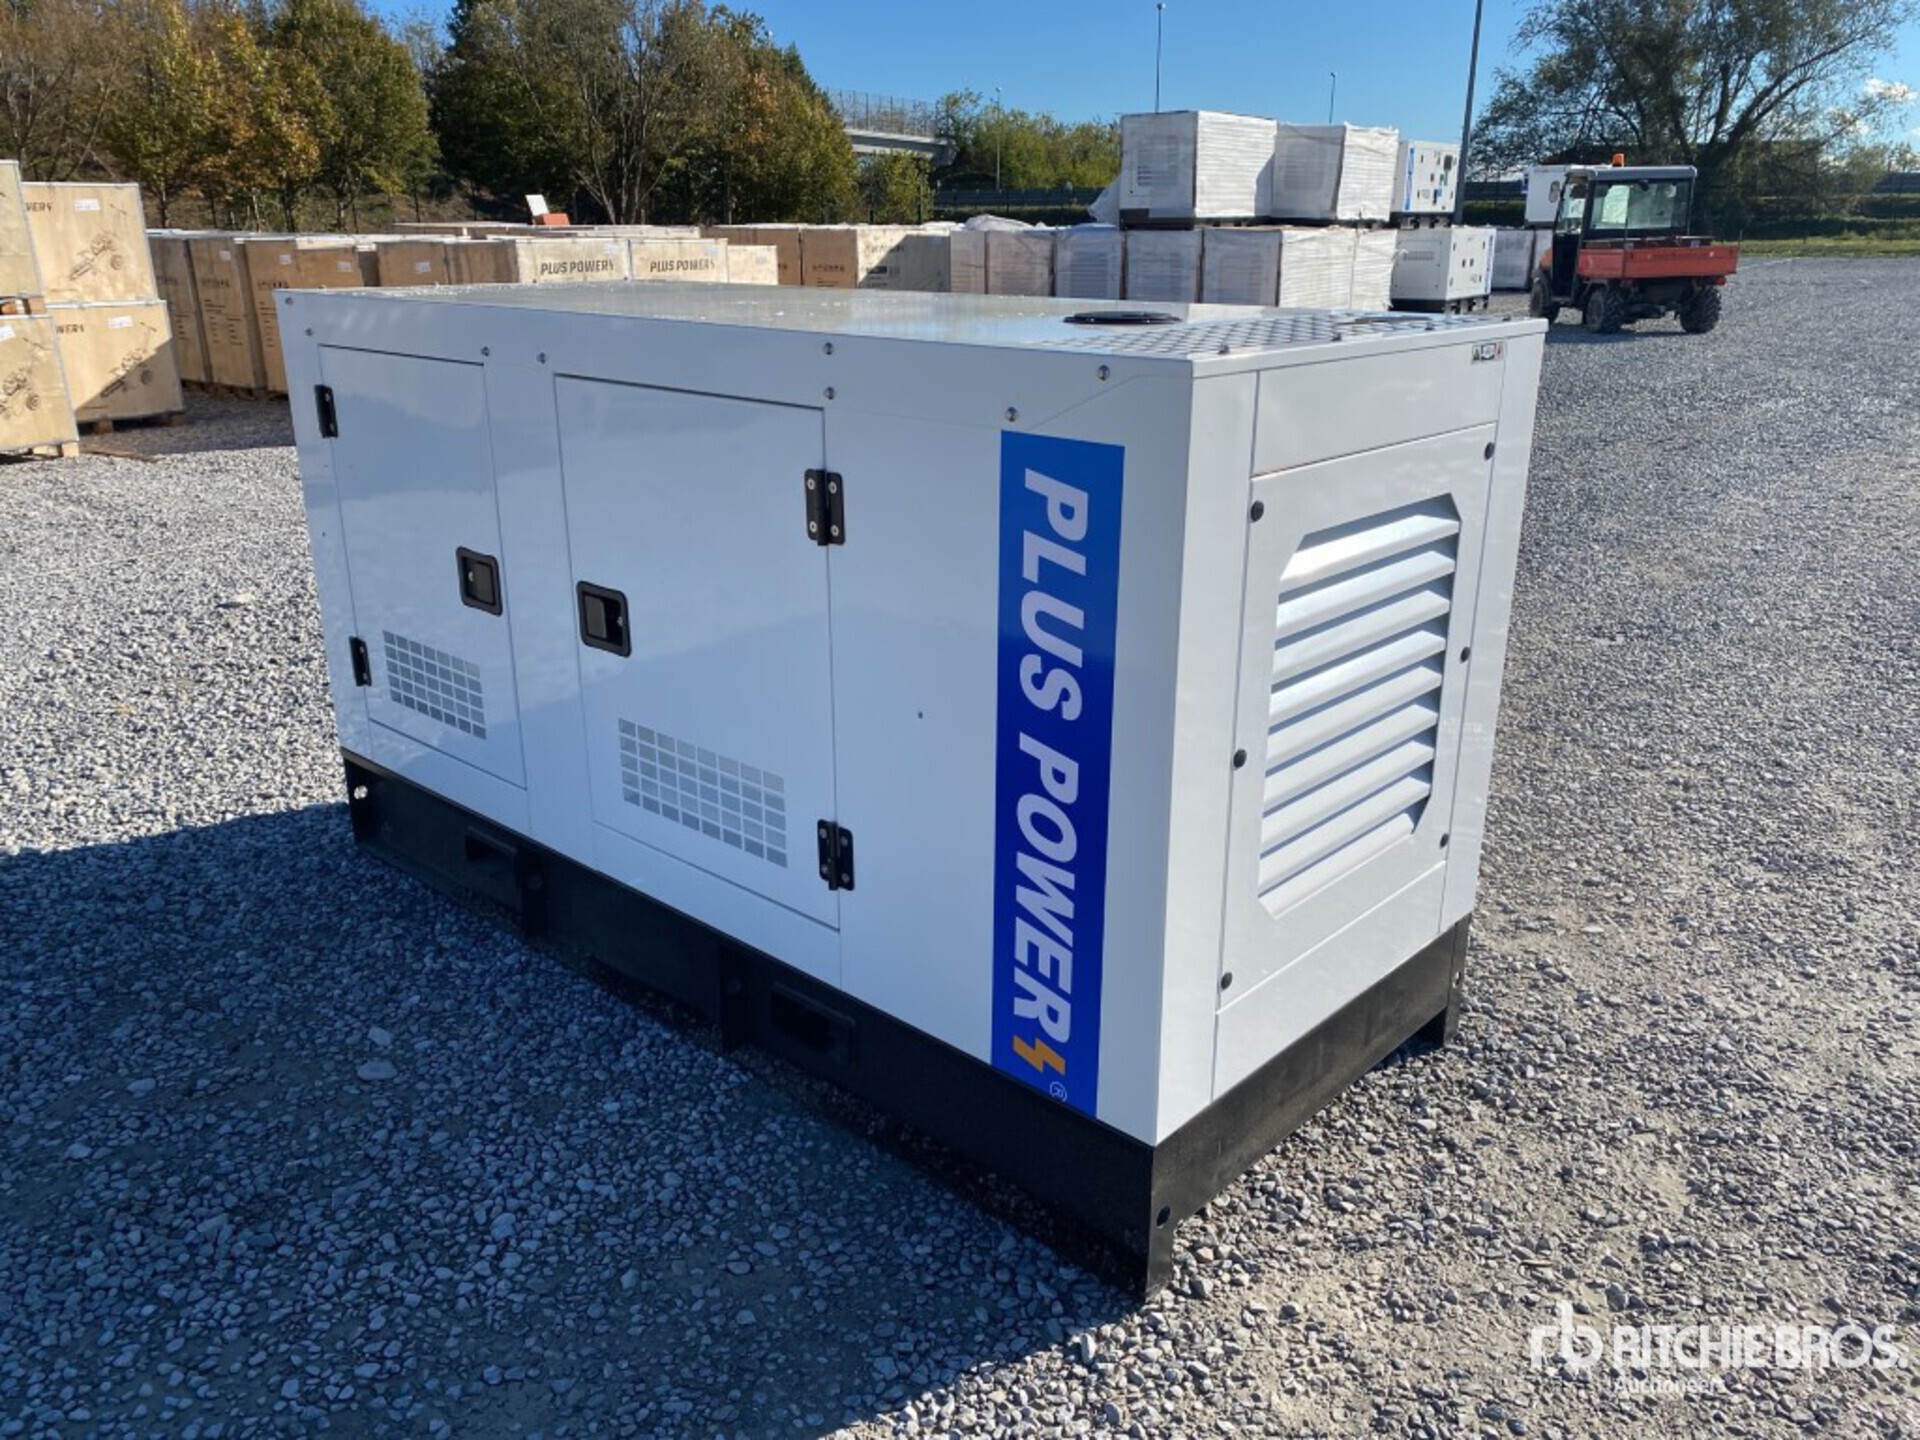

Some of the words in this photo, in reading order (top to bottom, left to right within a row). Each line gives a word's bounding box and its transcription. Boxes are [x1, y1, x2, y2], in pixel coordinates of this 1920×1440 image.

[540, 261, 567, 275] PLUS
[569, 259, 608, 273] POWER
[650, 259, 674, 272] PLUS
[1018, 466, 1090, 722] PLUS
[1012, 731, 1080, 1045] POWER
